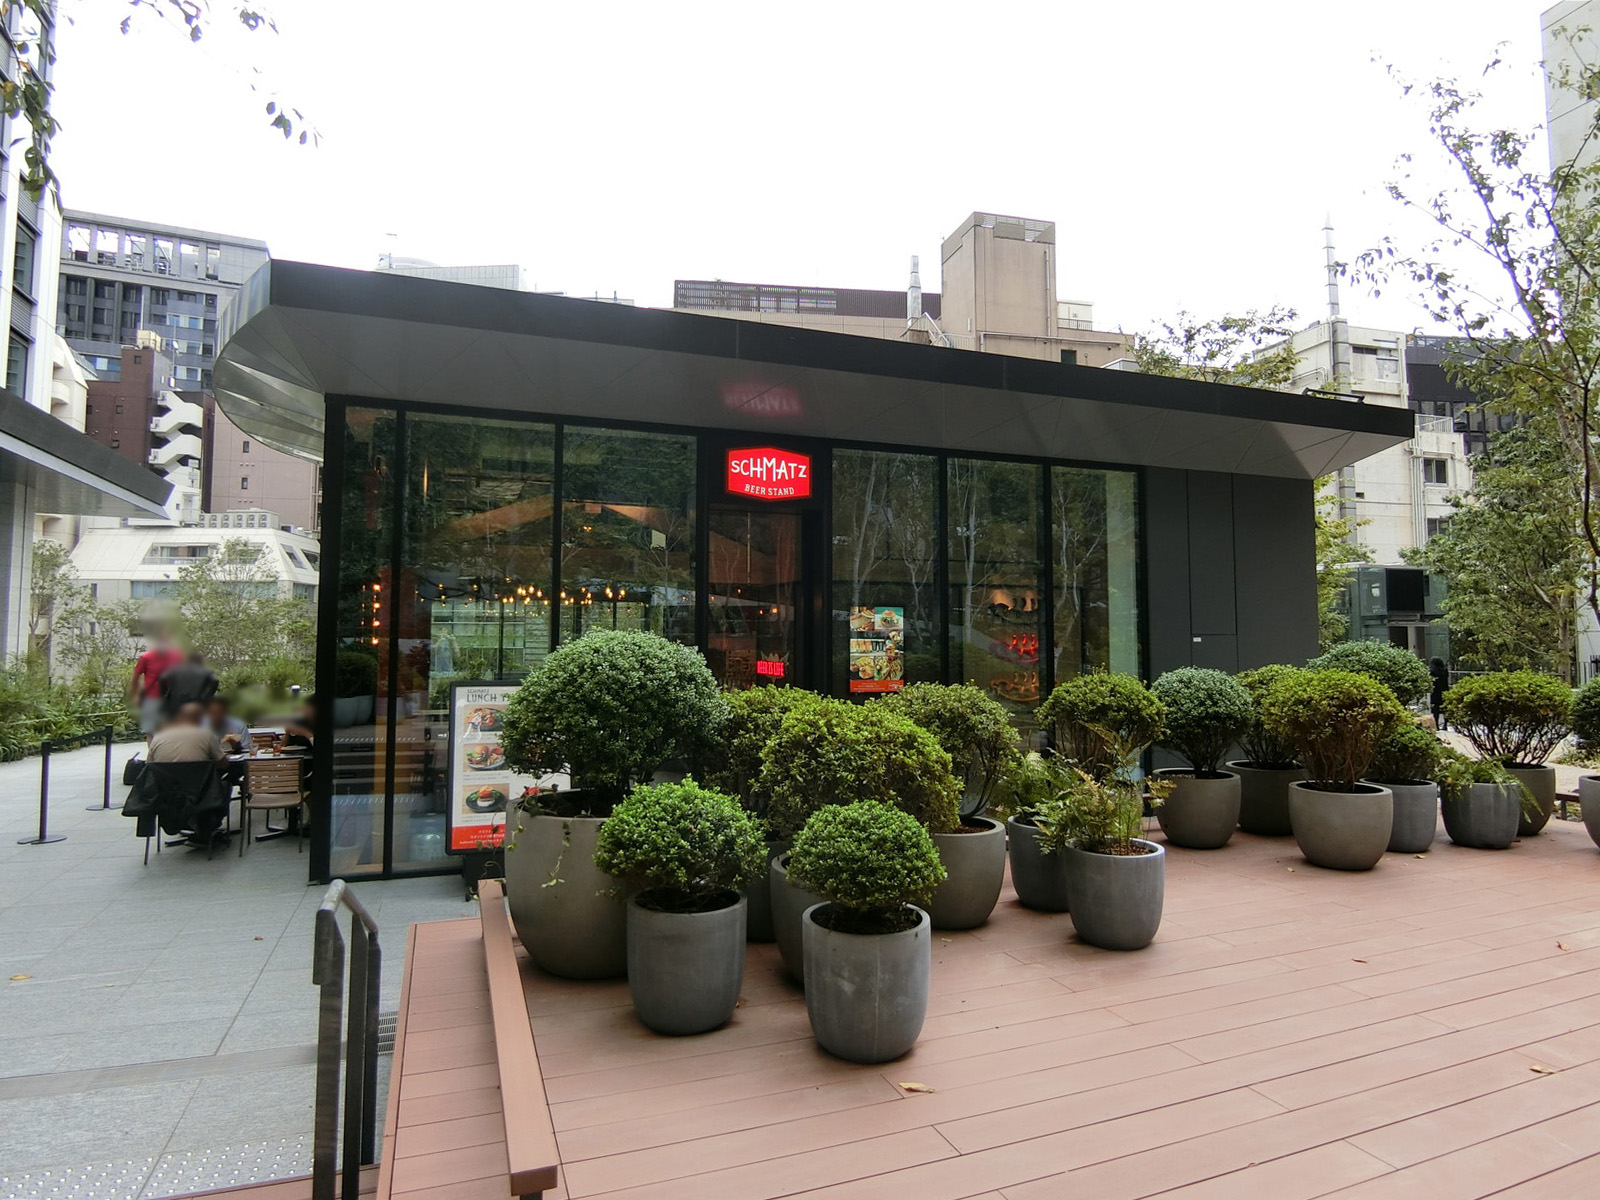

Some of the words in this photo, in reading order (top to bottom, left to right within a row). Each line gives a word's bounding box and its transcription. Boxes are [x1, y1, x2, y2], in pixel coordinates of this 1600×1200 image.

[731, 456, 807, 482] SCHMATZ
[744, 483, 766, 495] BEER
[767, 487, 795, 496] STAND
[466, 694, 497, 703] LUNCH
